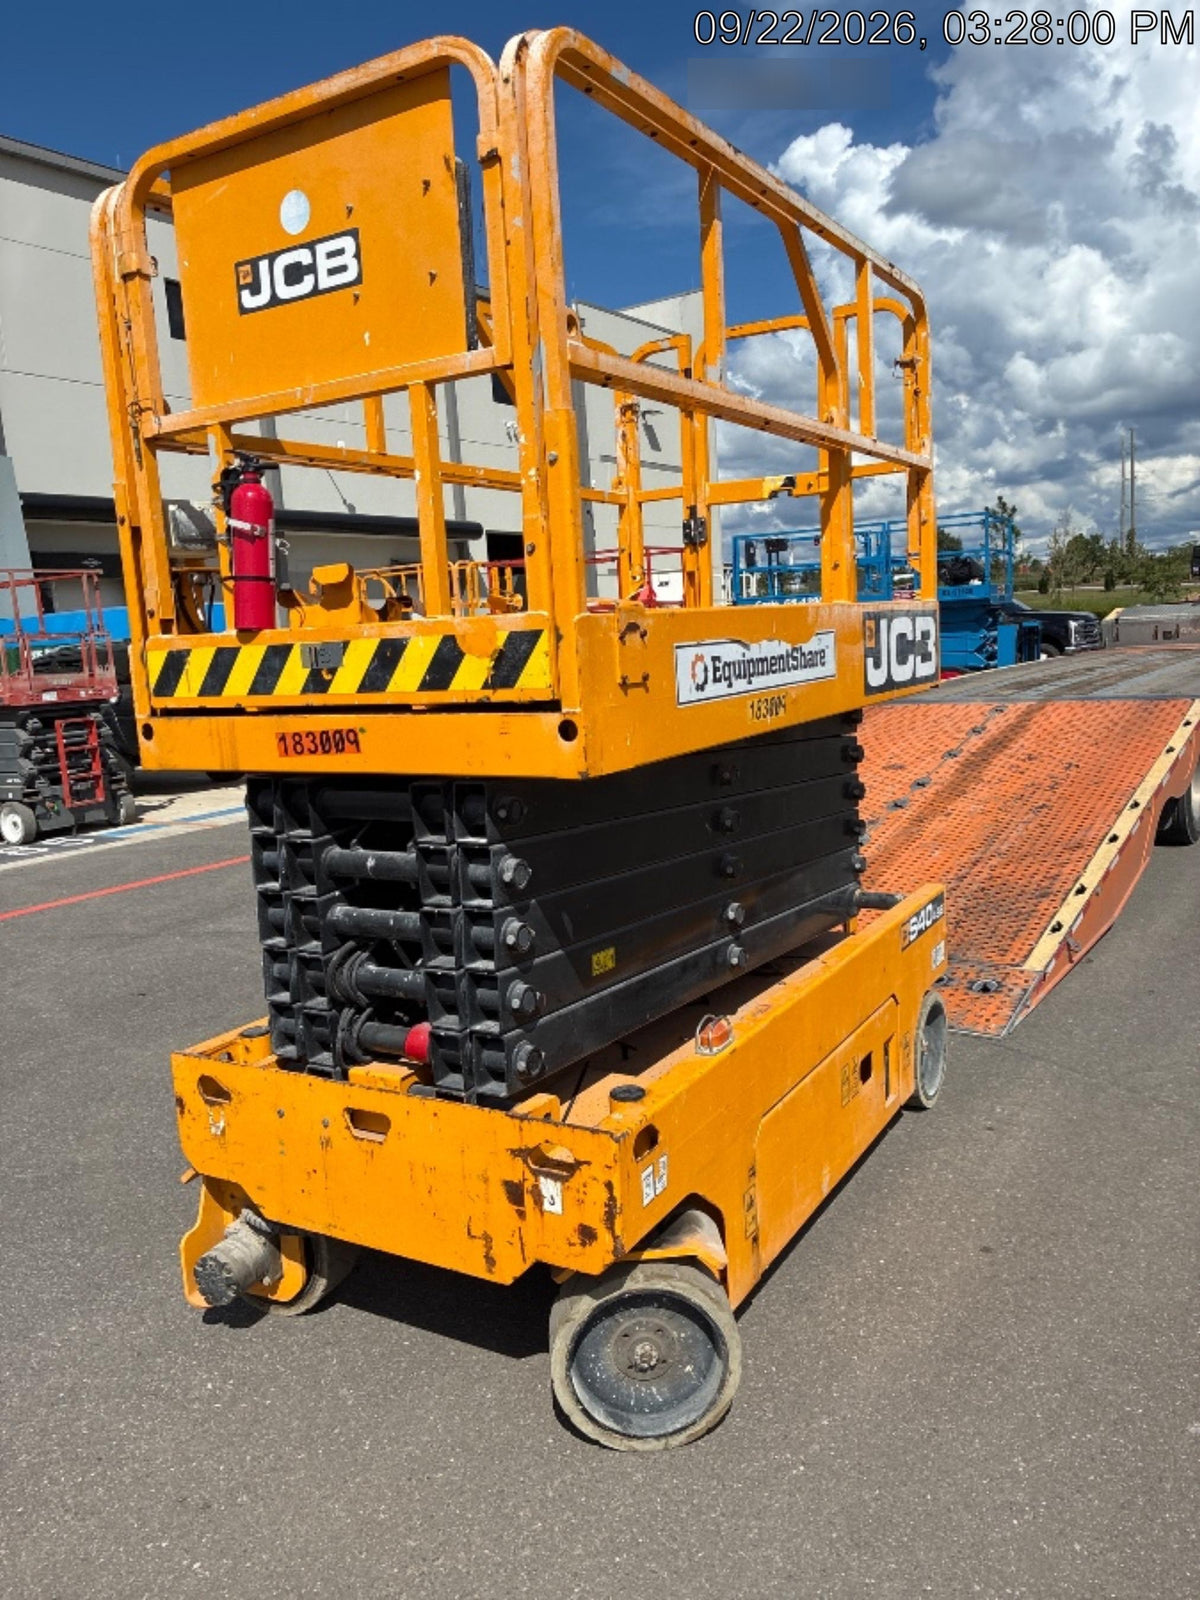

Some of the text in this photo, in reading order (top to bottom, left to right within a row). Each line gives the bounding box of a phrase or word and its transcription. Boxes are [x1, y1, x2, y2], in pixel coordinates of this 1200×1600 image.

[240, 235, 359, 309] JCB
[710, 646, 827, 688] EquipmentShare
[866, 615, 937, 688] JCB
[278, 728, 360, 756] 183009
